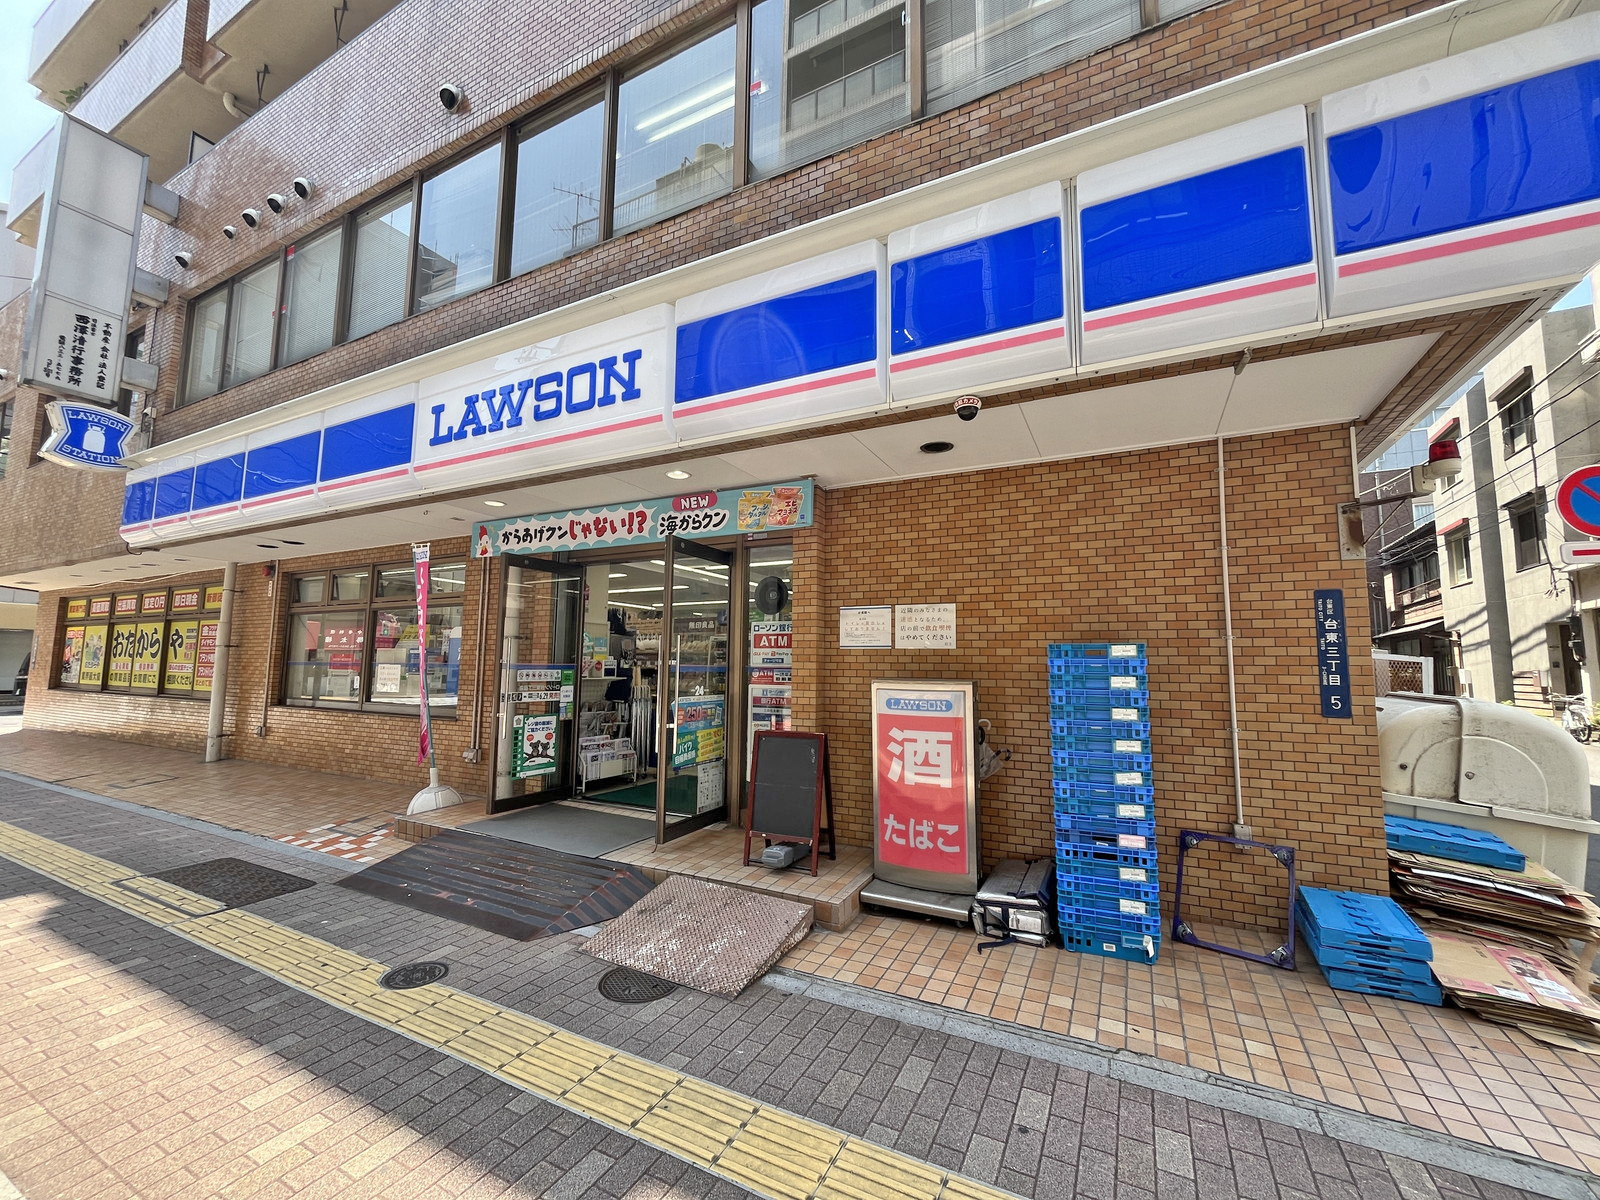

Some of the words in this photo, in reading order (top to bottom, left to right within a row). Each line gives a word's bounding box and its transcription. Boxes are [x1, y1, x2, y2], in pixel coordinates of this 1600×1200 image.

[429, 349, 642, 446] LAWSON
[68, 410, 127, 432] LAWSON
[62, 444, 120, 463] STATION
[680, 495, 709, 511] NEW
[659, 511, 727, 536] 海からクン
[501, 525, 568, 545] からあげクン
[113, 627, 184, 660] おたからや
[760, 635, 788, 647] ATM
[900, 633, 952, 641] はやめてください
[1324, 618, 1341, 686] 台東三丁目
[695, 685, 704, 695] 24
[890, 699, 947, 711] LAWSON
[1330, 695, 1342, 710] 5
[679, 741, 692, 754] バイク
[886, 727, 953, 788] 酒
[883, 813, 961, 853] たばこ
